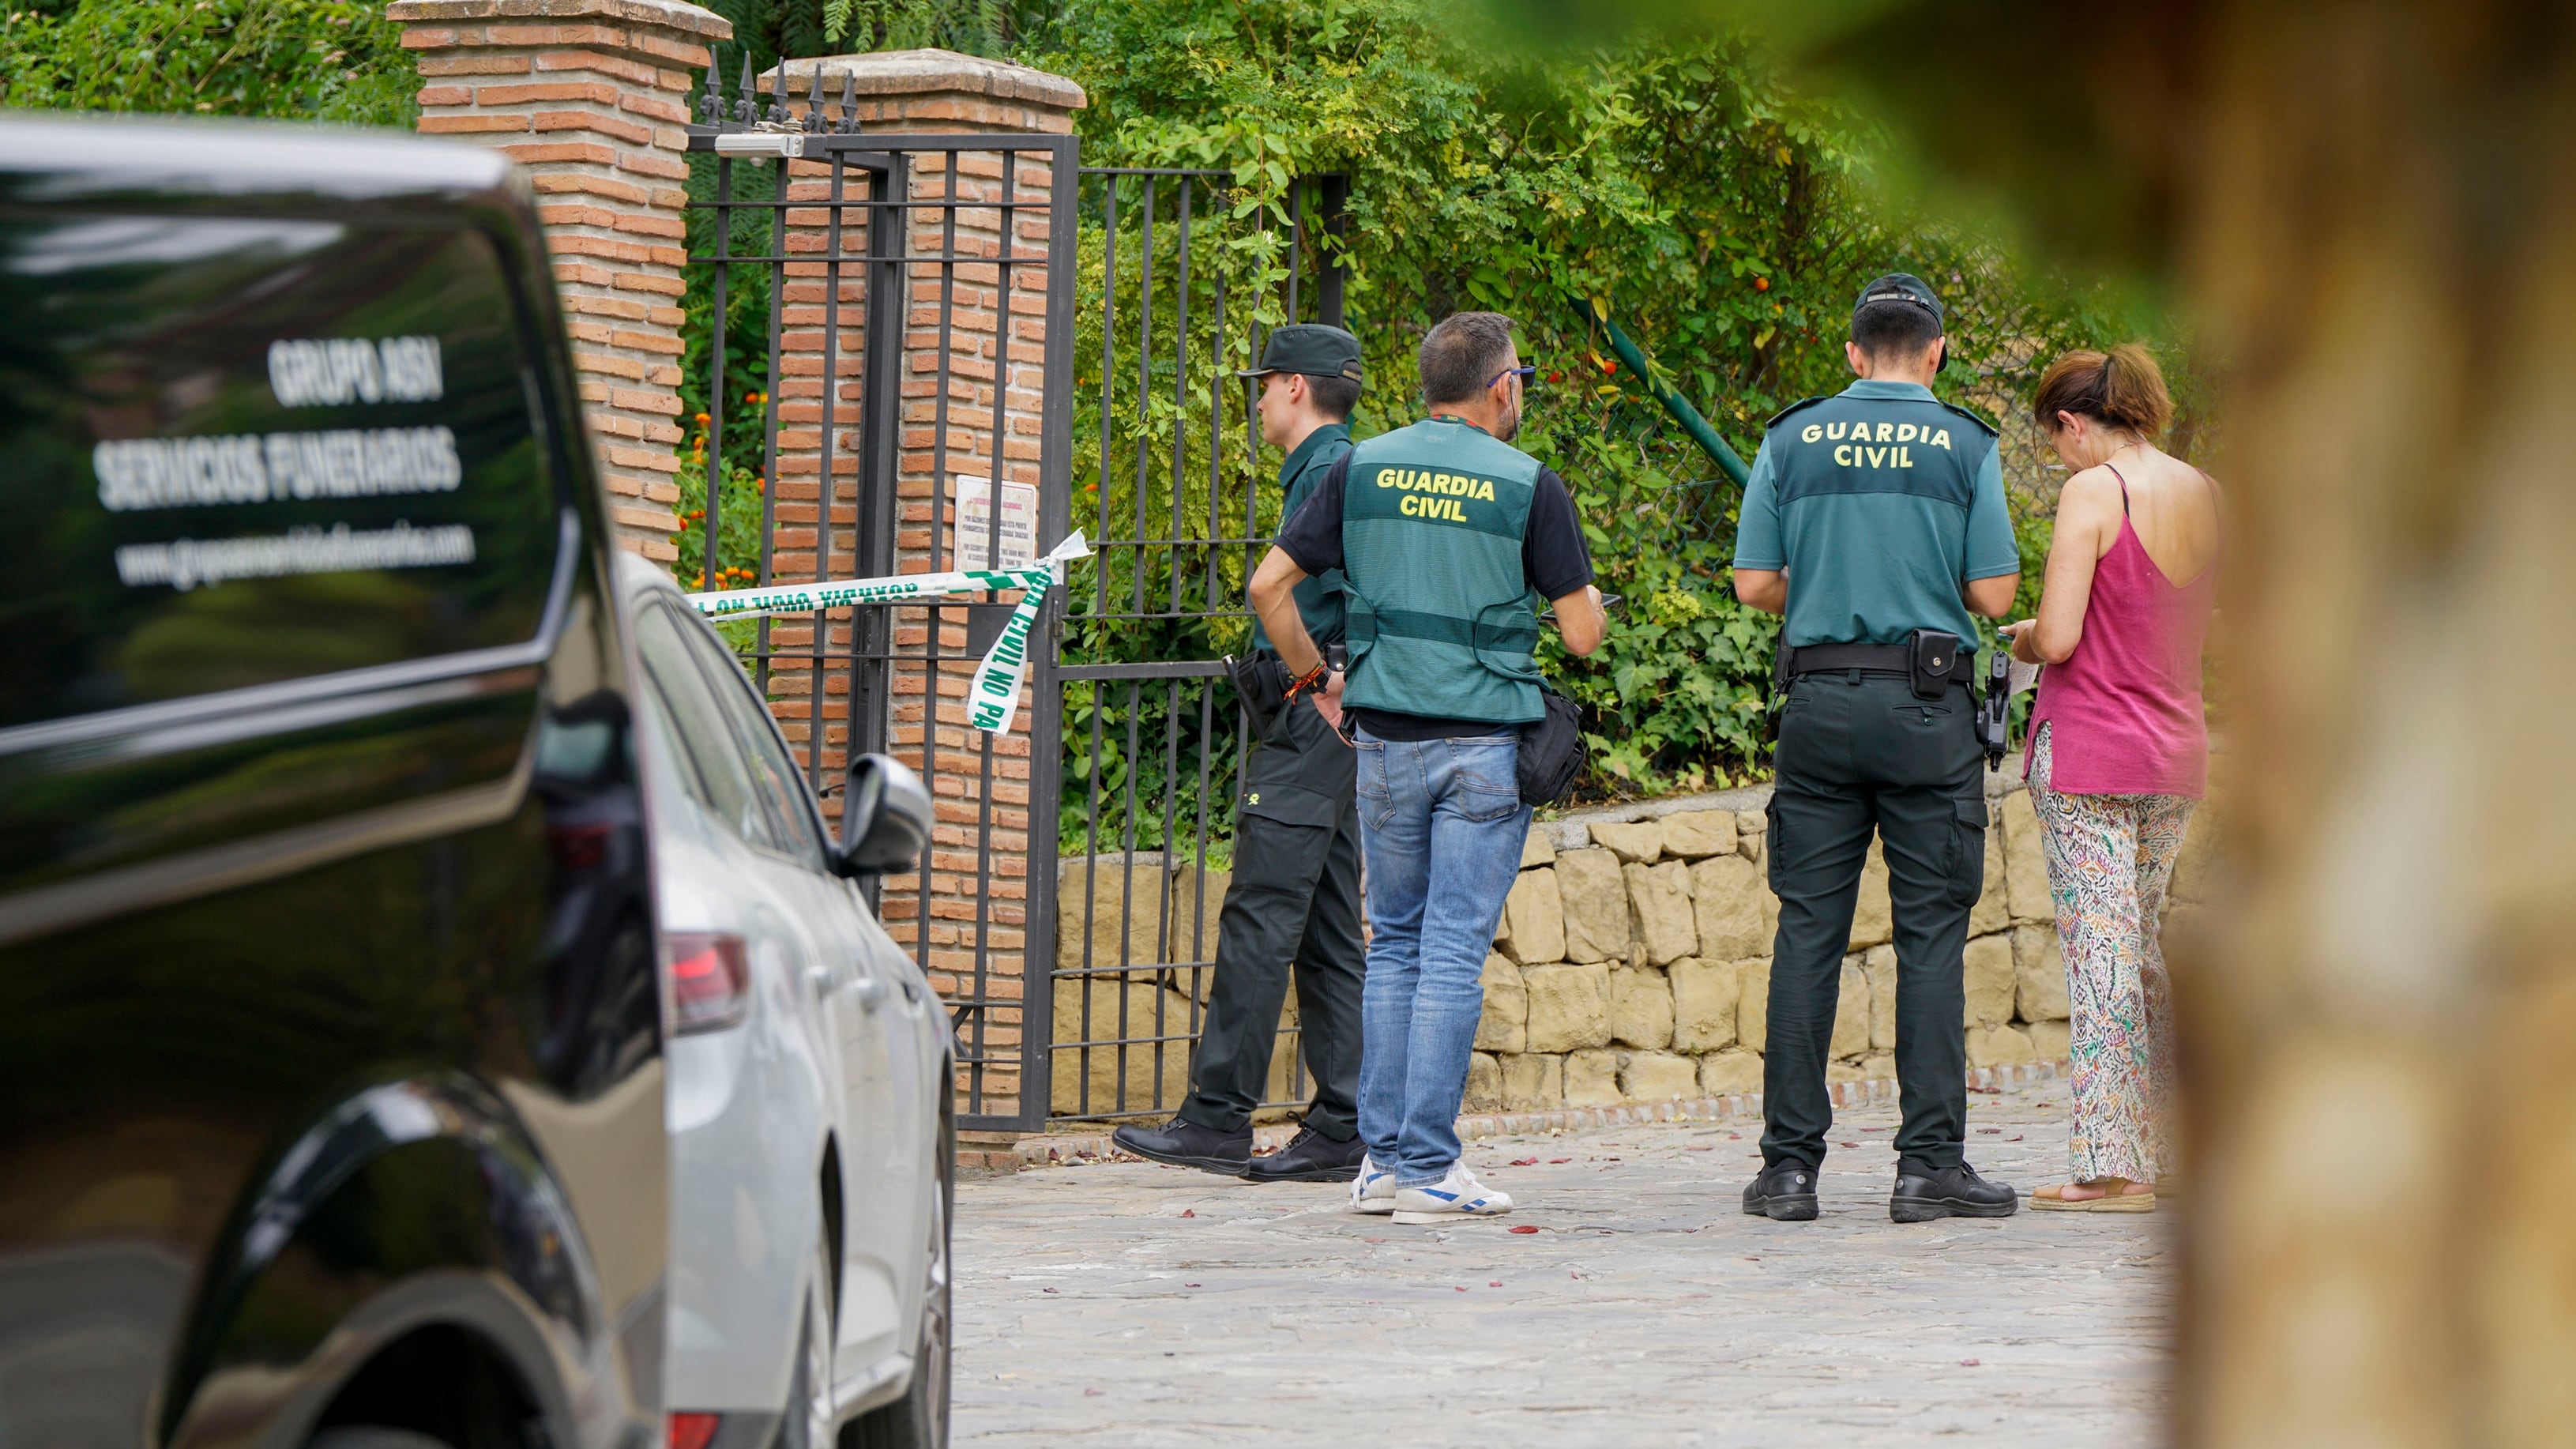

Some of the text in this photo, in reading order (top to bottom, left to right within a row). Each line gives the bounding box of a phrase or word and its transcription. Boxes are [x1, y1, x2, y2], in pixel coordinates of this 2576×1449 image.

[267, 337, 382, 407] GRUPO
[1801, 422, 1951, 450] GUARDIA
[93, 424, 462, 511] SERVICIOS FUNERARIOS
[1833, 445, 1913, 469] CIVIL
[1377, 469, 1495, 502] GUARDIA
[1400, 495, 1467, 522] CIVIL
[991, 612, 1033, 667] CIVIL
[981, 668, 1015, 698] NO
